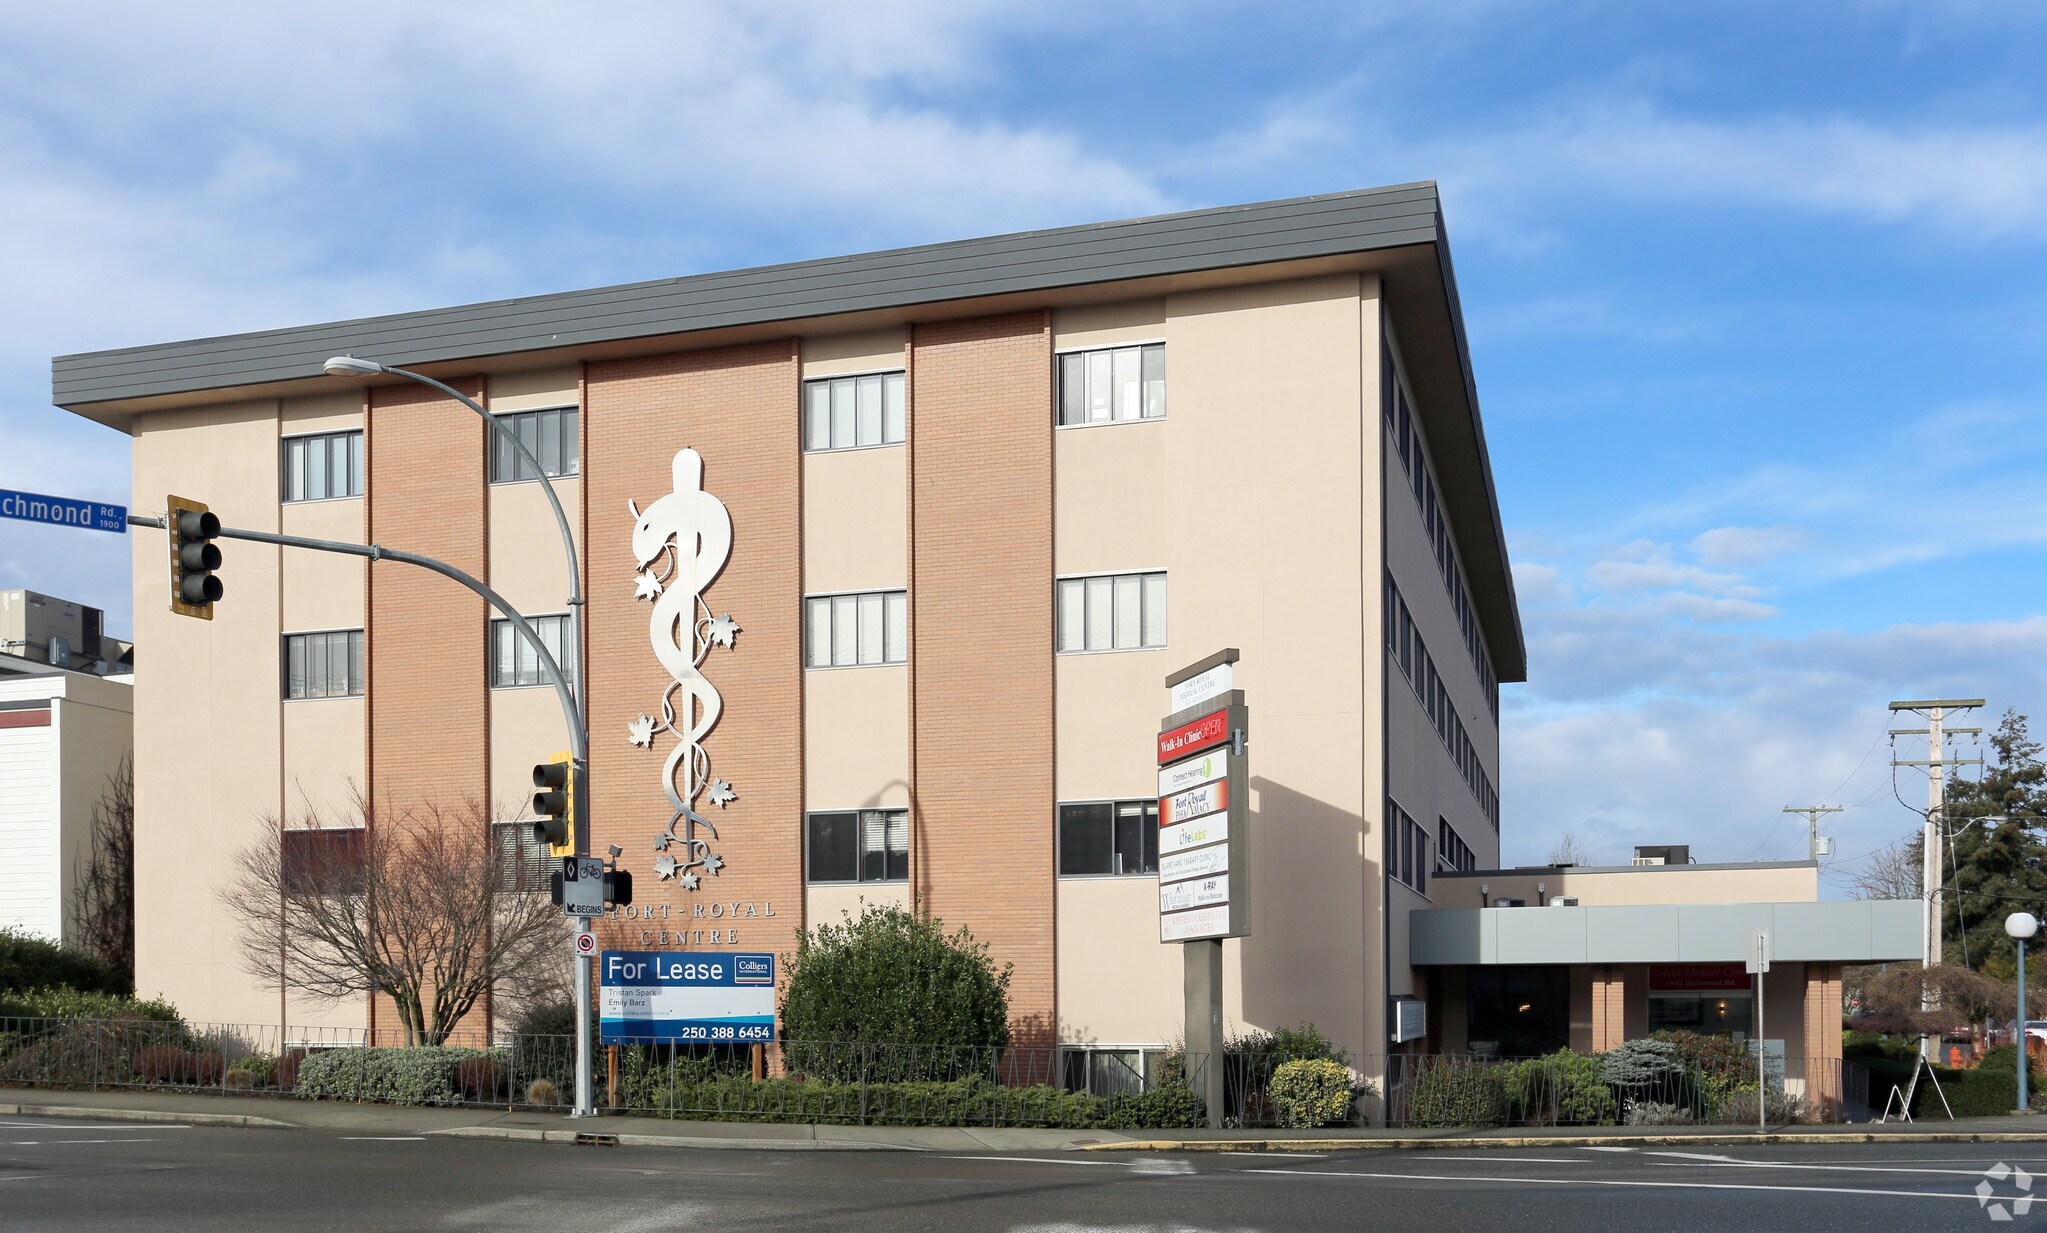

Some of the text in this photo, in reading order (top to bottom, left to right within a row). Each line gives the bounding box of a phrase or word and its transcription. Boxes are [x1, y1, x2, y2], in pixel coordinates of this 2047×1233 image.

[100, 519, 120, 529] 1900
[1199, 679, 1216, 692] CENTRE
[1160, 718, 1222, 753] Walk-In Clinic OPEN
[1173, 767, 1203, 783] Connect Hearing
[1175, 790, 1207, 812] Fort Royal
[1175, 800, 1211, 820] PHARMACY
[1183, 855, 1199, 866] THERAPY
[1199, 852, 1212, 862] CLINIC
[1203, 880, 1217, 891] X-RAY
[576, 905, 602, 914] BEGINS
[1172, 909, 1227, 926] WESTERN CARDIOLOGY
[1184, 922, 1214, 936] ASSOCIATES
[640, 929, 739, 945] CENTRE
[608, 956, 723, 980] For Lease
[739, 961, 768, 970] Colliers
[1722, 966, 1747, 977] Clini
[635, 989, 657, 998] Spark
[608, 999, 628, 1007] Emily
[682, 1027, 769, 1038] 250 388 6454
